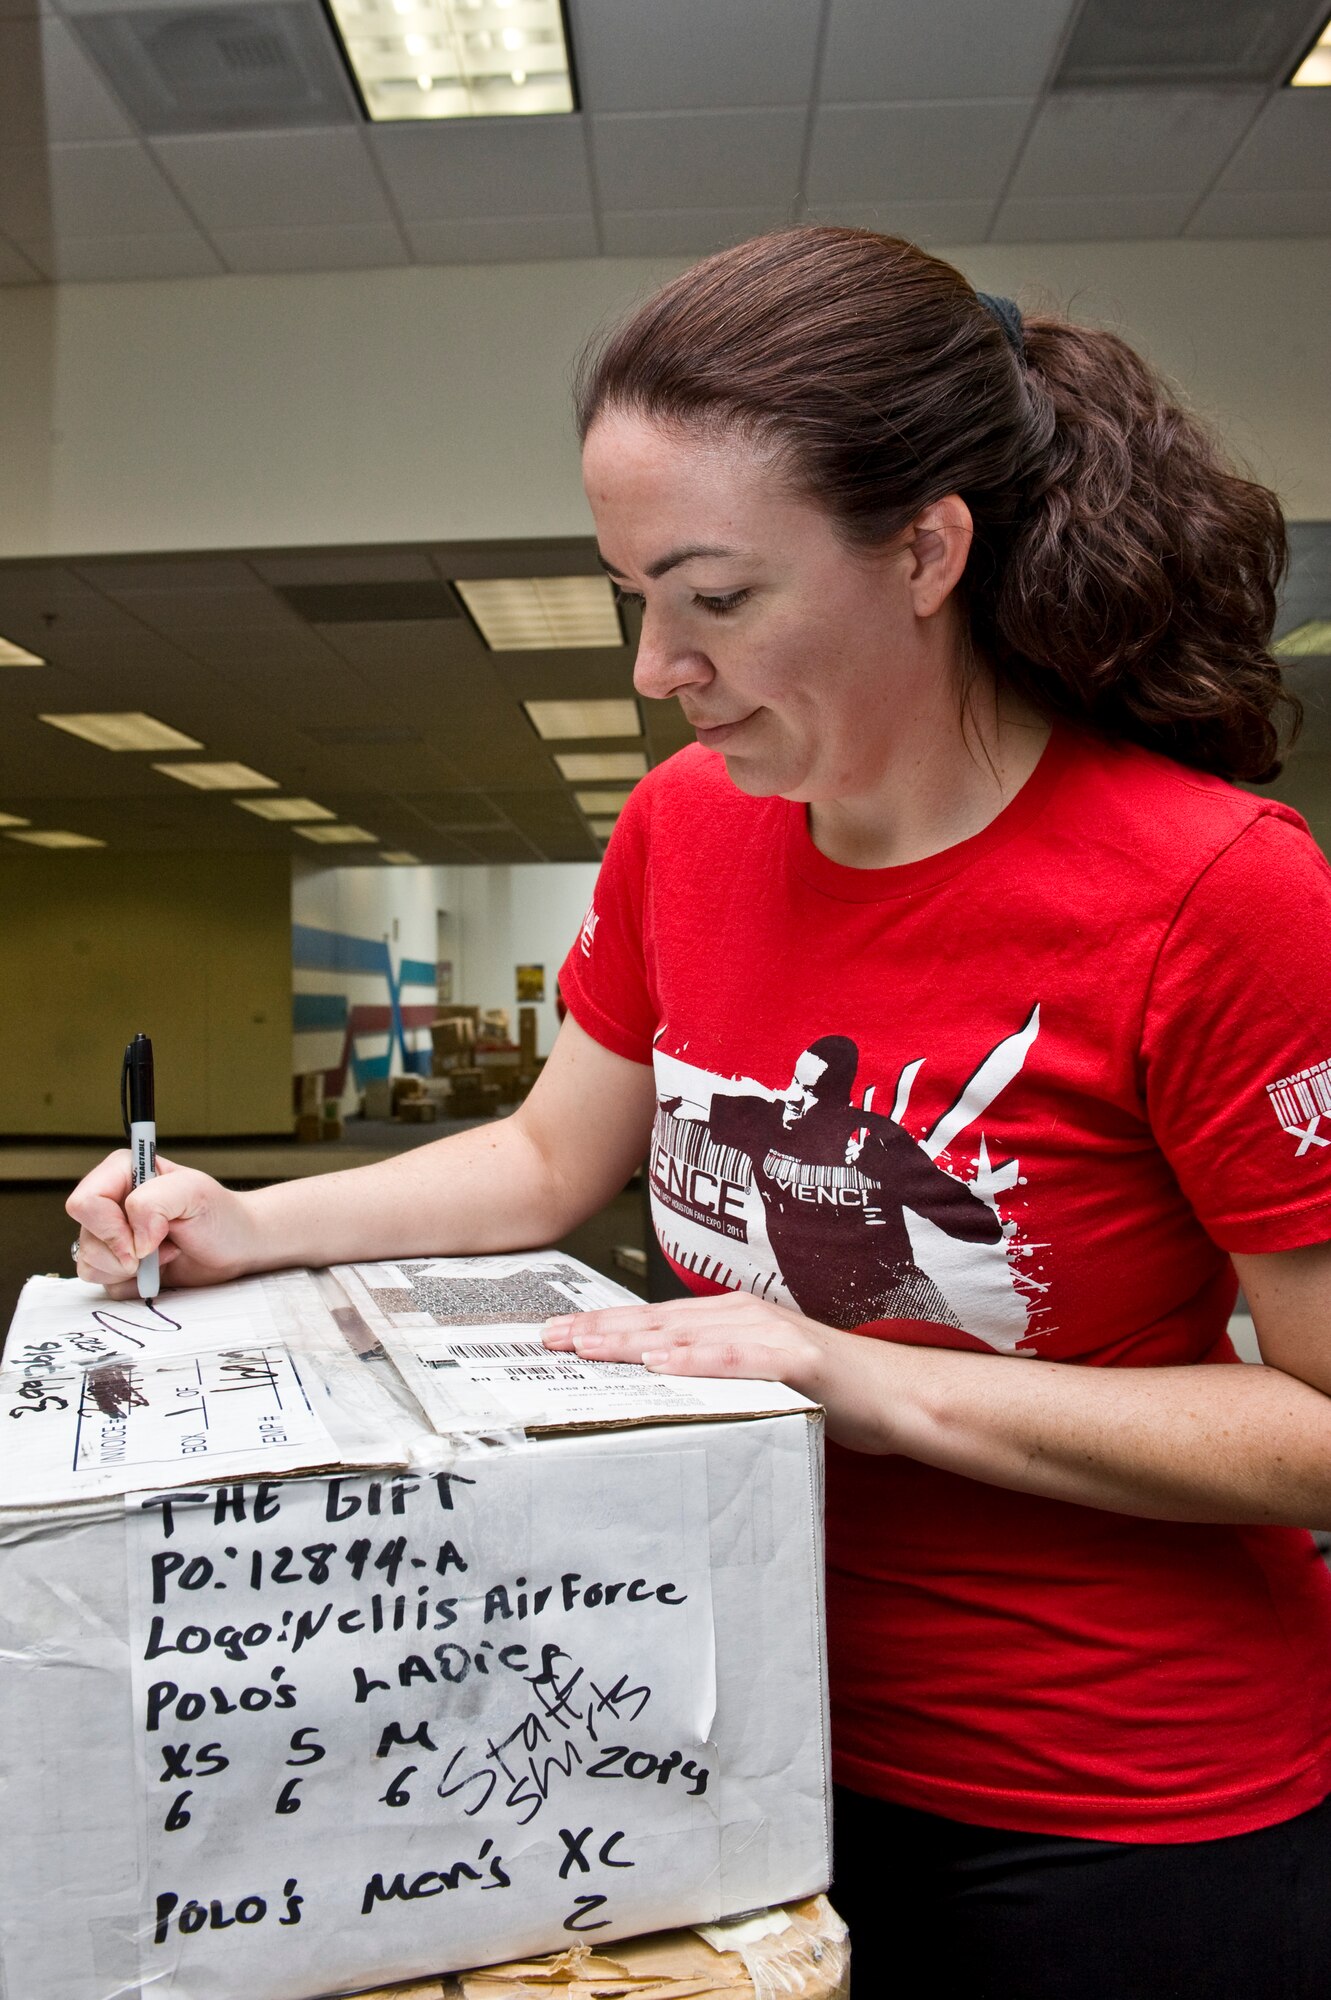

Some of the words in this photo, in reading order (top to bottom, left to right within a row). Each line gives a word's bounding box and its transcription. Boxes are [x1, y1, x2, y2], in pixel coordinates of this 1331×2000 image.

[138, 1138, 146, 1184] ETRACTABLE
[649, 1143, 746, 1217] IENCE
[672, 1199, 694, 1217] HOUSTON
[693, 1210, 705, 1222] FAN
[706, 1216, 721, 1230] EXPO
[726, 1224, 744, 1239] 2011
[175, 1387, 200, 1398] OF
[100, 1425, 127, 1463] INVOICE
[181, 1432, 208, 1454] BOX
[259, 1423, 288, 1443] EMP
[142, 1481, 284, 1538] THE
[326, 1472, 476, 1522] GIFT
[160, 1742, 230, 1782] XS
[285, 1727, 327, 1766] S
[376, 1721, 439, 1758] M
[164, 1790, 194, 1832] 6
[275, 1777, 303, 1814] 6
[378, 1766, 418, 1807] 6
[563, 1894, 613, 1931] 2
